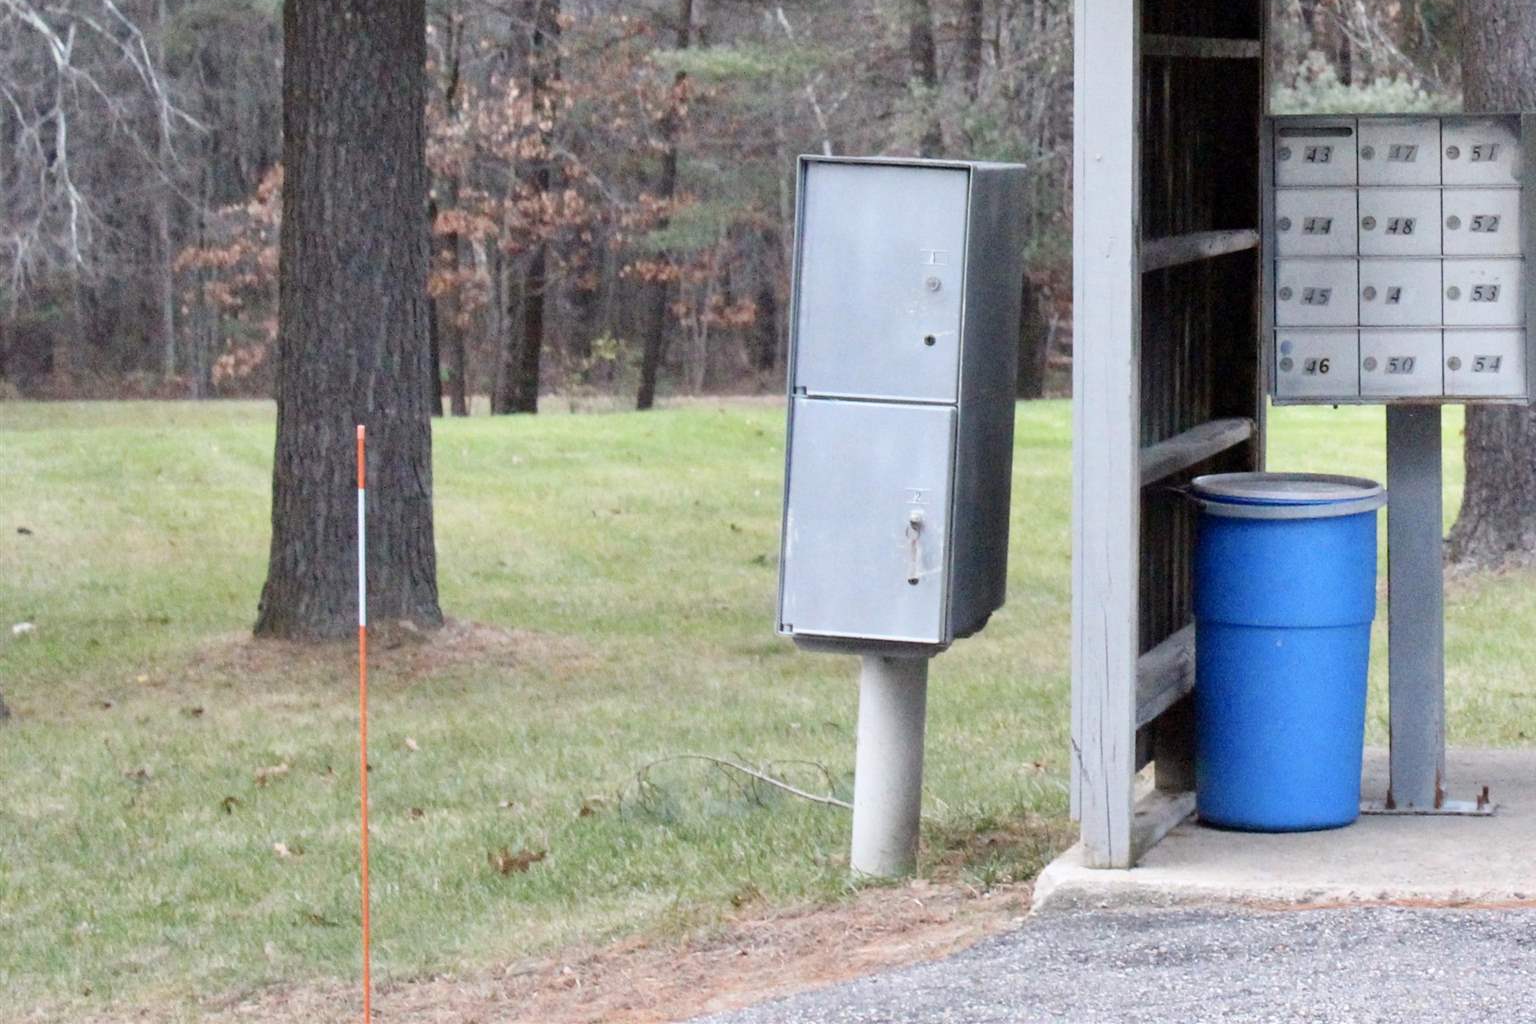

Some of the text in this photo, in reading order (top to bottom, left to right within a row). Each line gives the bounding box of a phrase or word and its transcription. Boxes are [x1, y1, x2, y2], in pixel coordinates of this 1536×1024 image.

[1306, 147, 1331, 163] 43
[1471, 147, 1495, 161] 51
[1304, 219, 1332, 234] 44
[1388, 219, 1413, 234] 48
[1472, 217, 1498, 232] 52
[1303, 290, 1329, 304] 45
[1473, 286, 1498, 301] 53
[1306, 358, 1330, 373] 46
[1388, 358, 1414, 373] 50
[1473, 357, 1500, 372] 54
